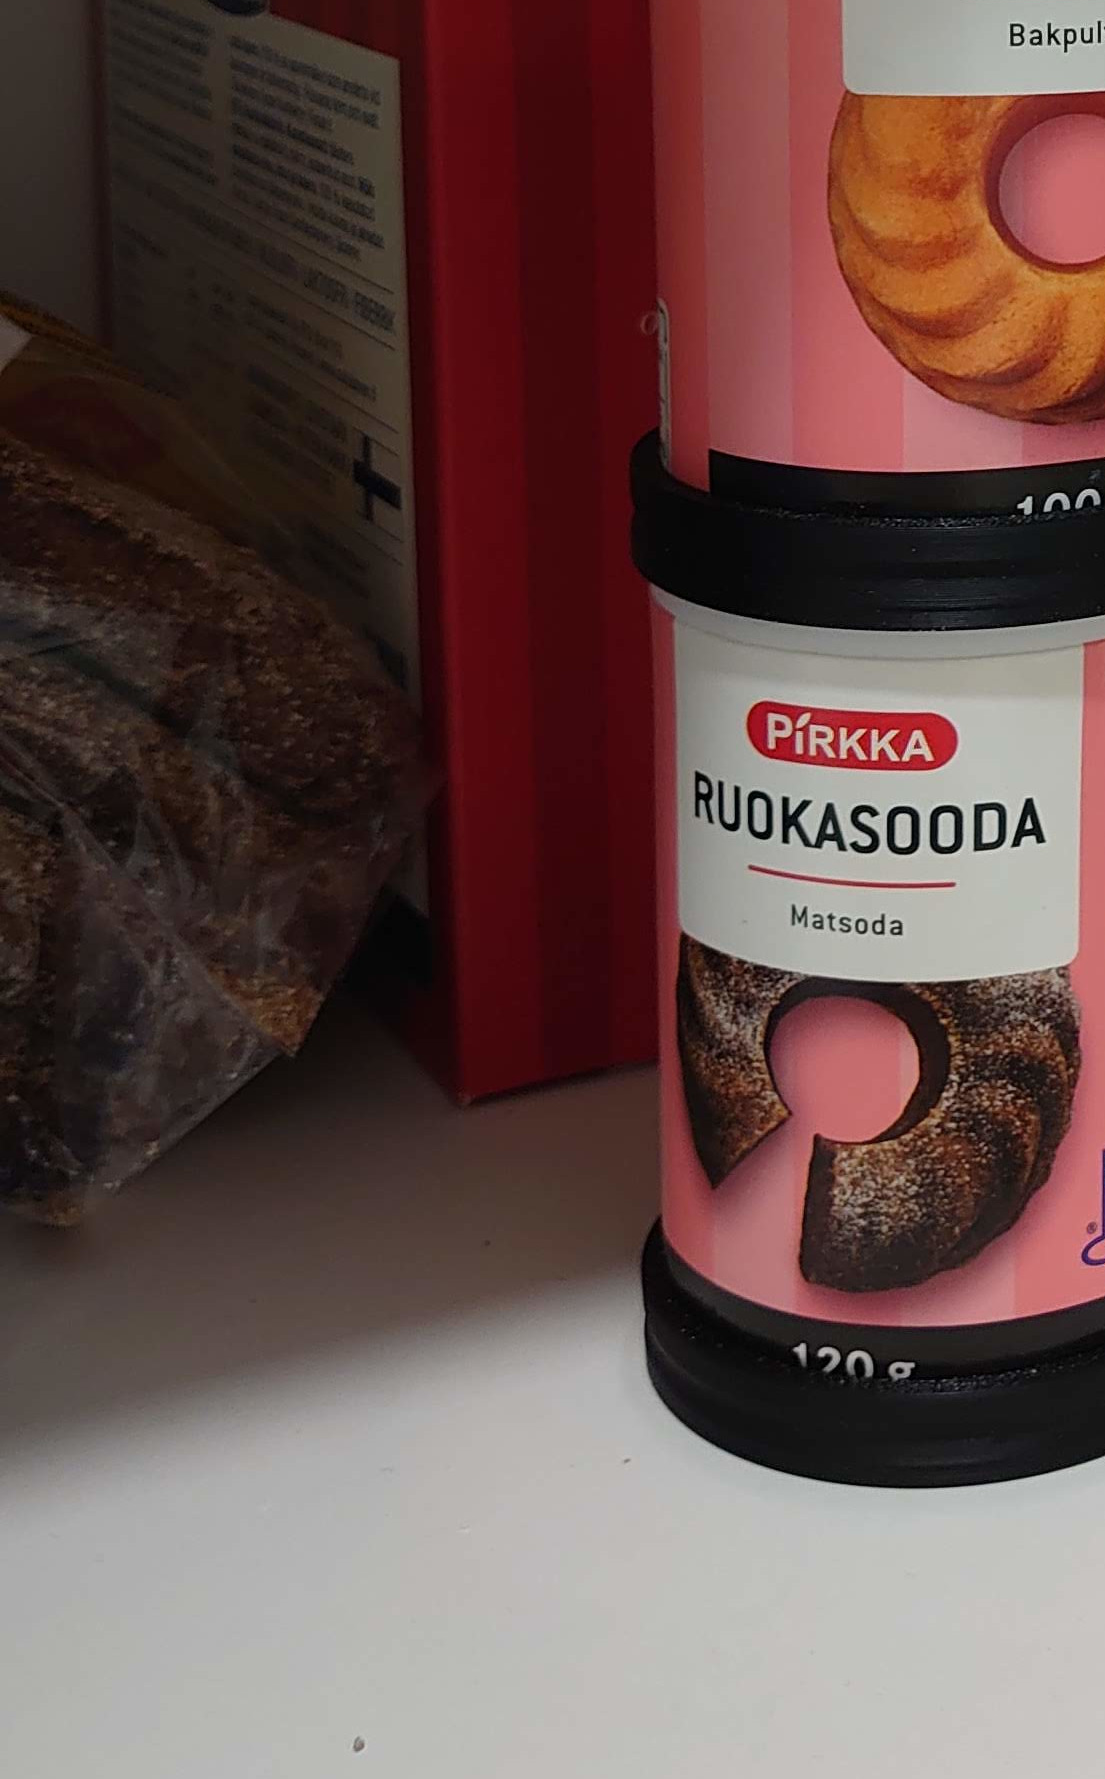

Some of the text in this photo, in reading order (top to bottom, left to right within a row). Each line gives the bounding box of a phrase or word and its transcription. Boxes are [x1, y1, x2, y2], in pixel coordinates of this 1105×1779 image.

[694, 769, 1047, 856] RUOKASOODA
[791, 903, 904, 936] Matsoda
[792, 1342, 874, 1378] 120
